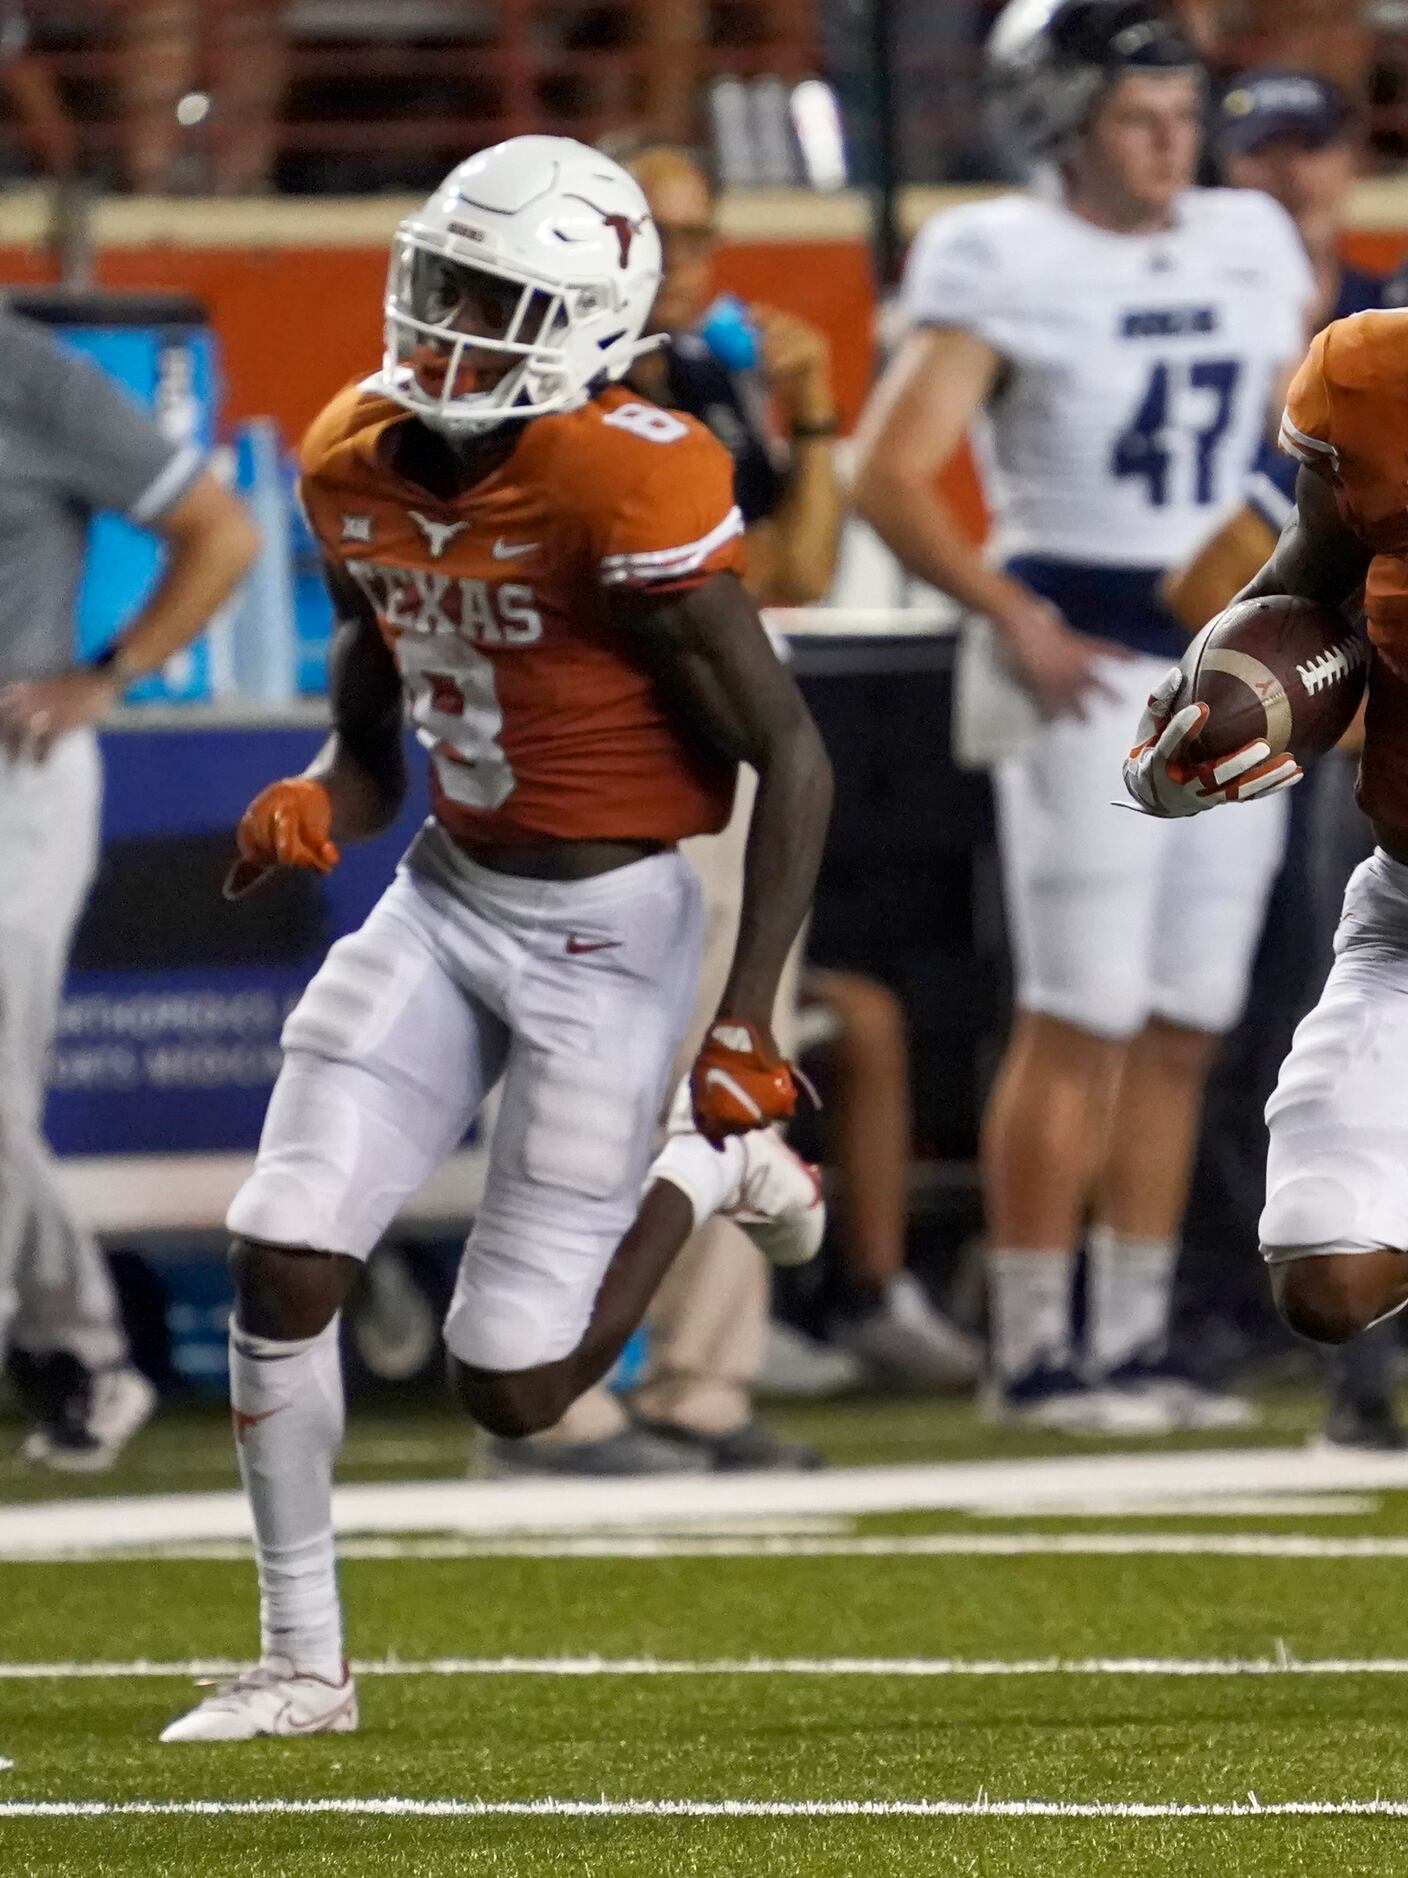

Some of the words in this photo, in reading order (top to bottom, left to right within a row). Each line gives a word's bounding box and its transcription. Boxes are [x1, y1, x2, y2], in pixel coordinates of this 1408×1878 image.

[602, 403, 688, 443] 8
[1108, 358, 1241, 507] 47
[345, 558, 544, 645] TEXAS
[394, 634, 518, 811] 8
